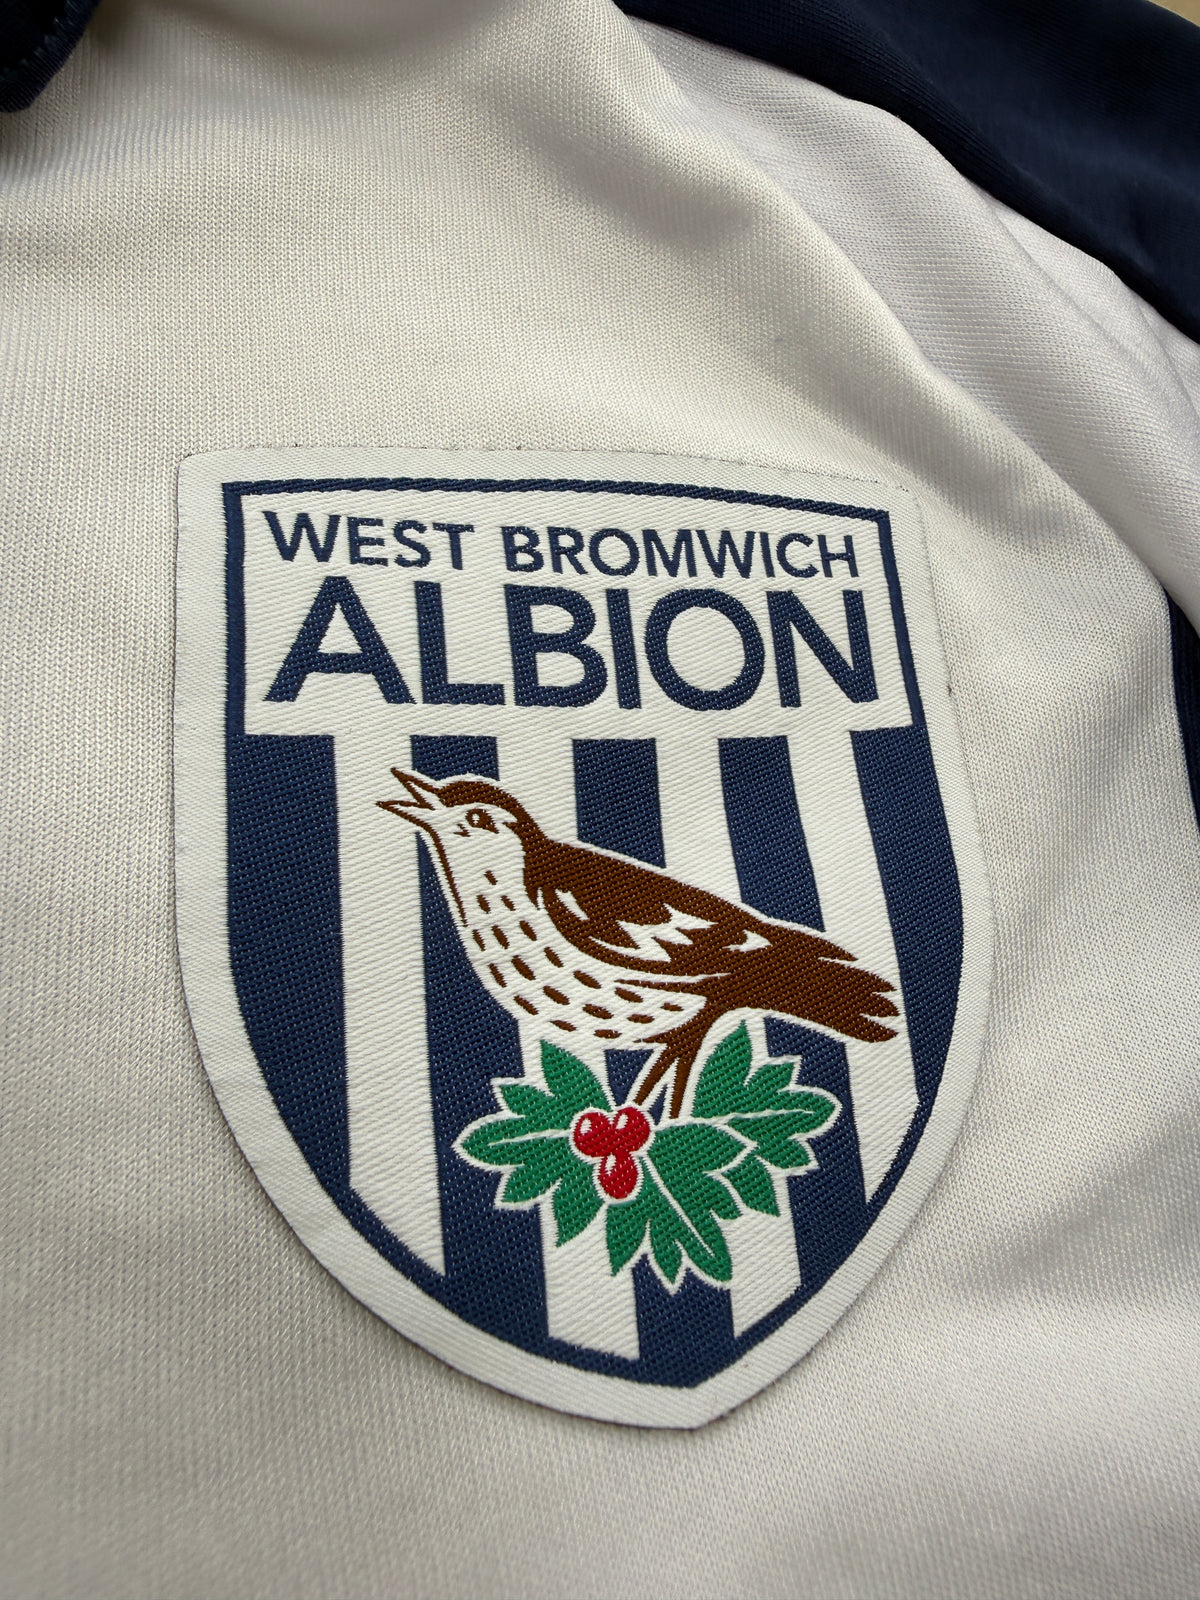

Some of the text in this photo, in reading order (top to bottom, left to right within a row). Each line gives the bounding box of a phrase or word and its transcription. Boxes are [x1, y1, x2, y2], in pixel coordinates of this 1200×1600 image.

[262, 511, 859, 580] WEST BROMWICH
[262, 576, 879, 711] ALBION
